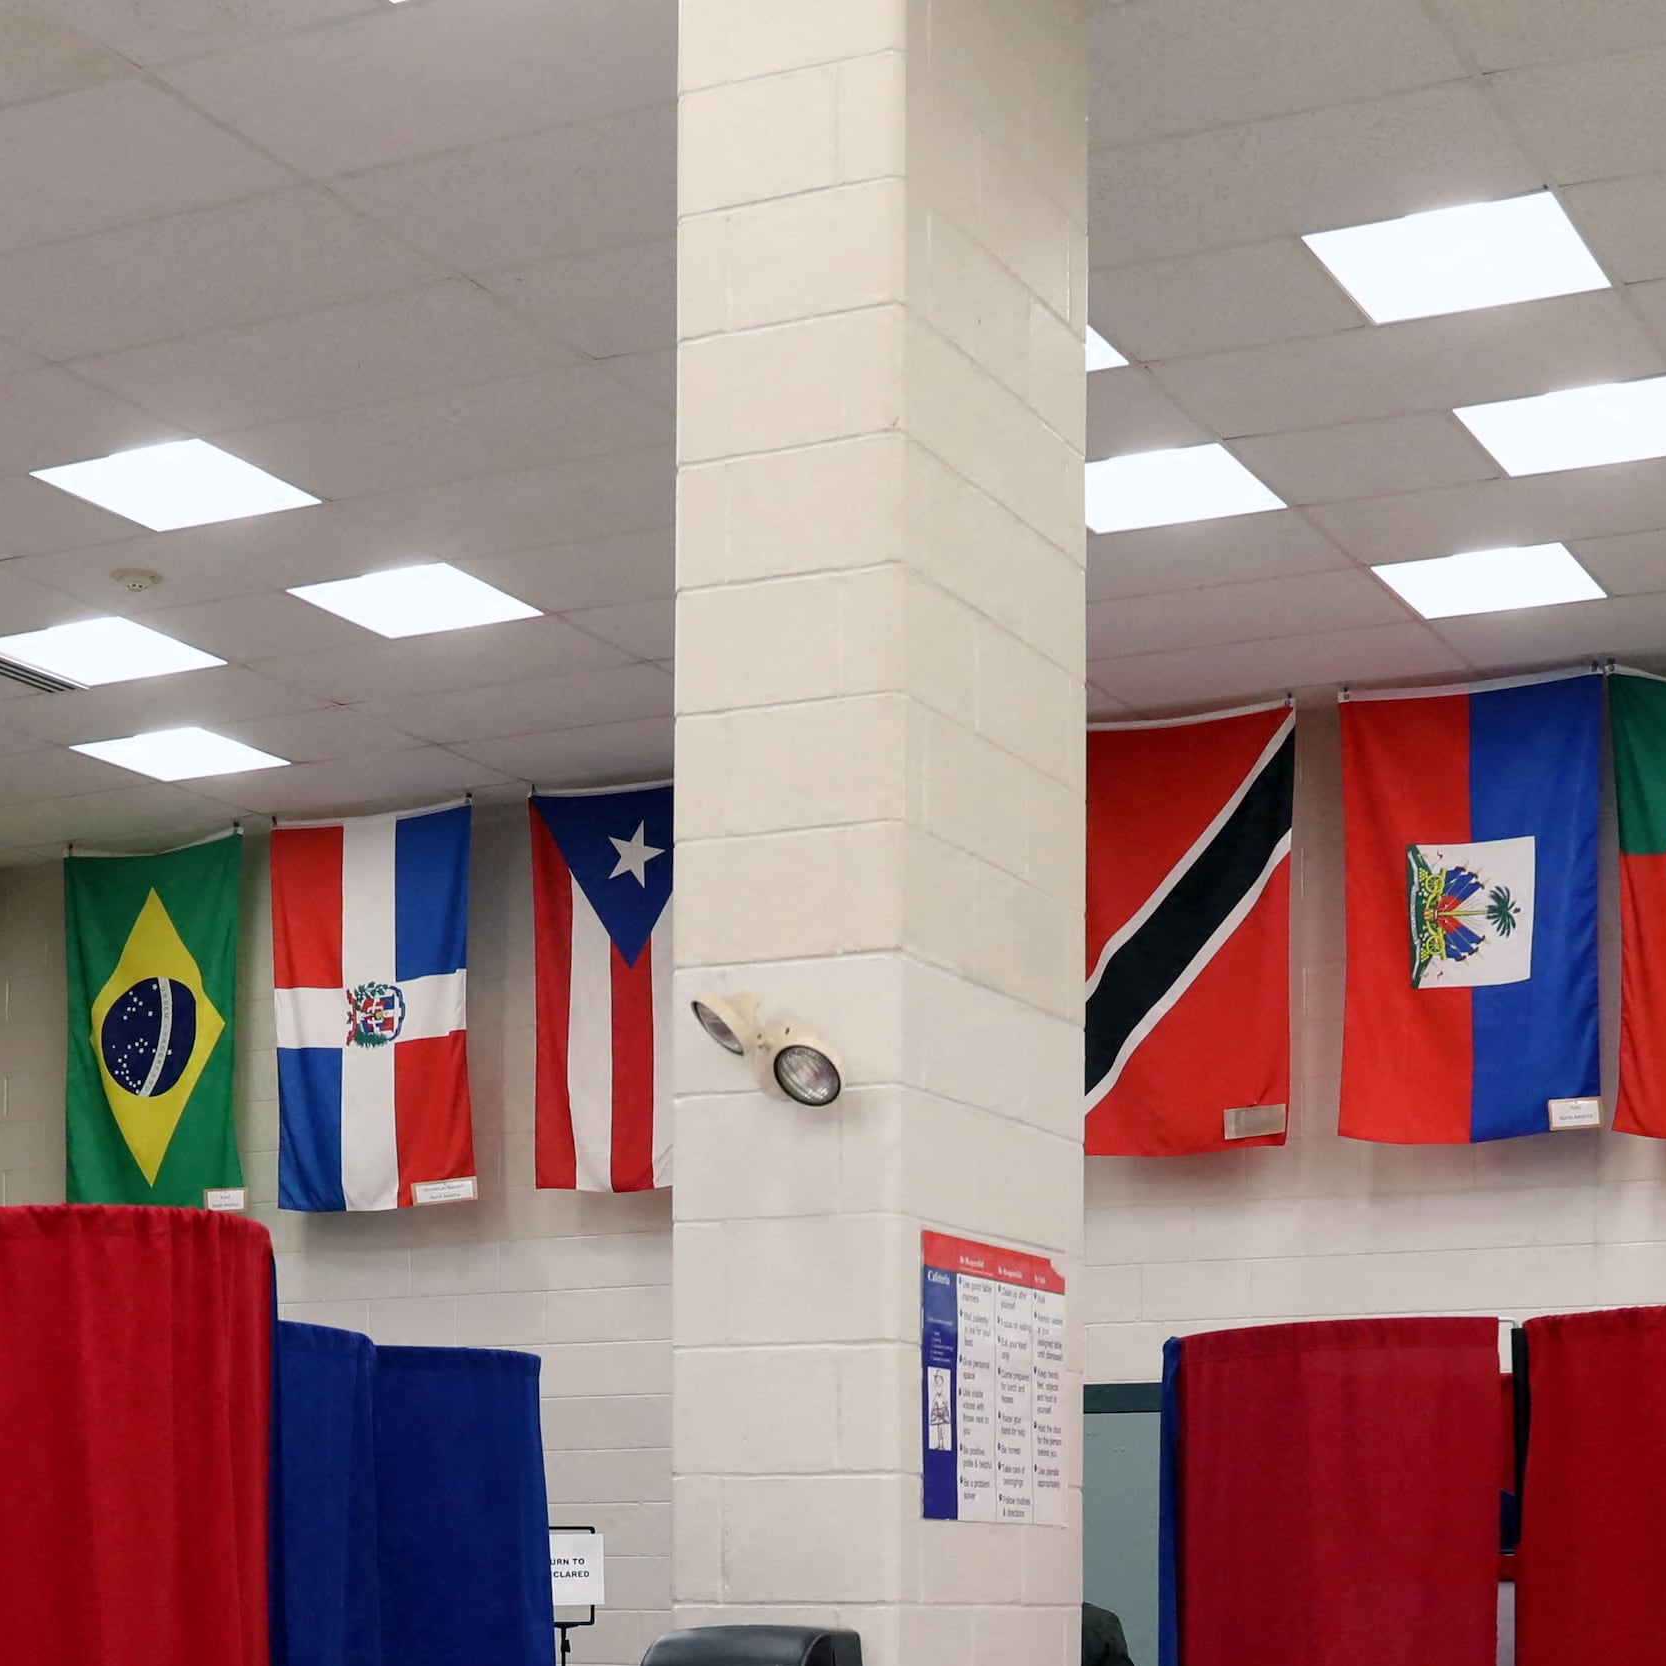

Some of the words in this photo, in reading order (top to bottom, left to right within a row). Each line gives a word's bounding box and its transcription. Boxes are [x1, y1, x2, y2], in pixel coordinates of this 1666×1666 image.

[927, 1270, 950, 1286] Cafeteria
[550, 1558, 570, 1566] URN
[572, 1558, 585, 1566] TO
[553, 1570, 590, 1578] CLARED
